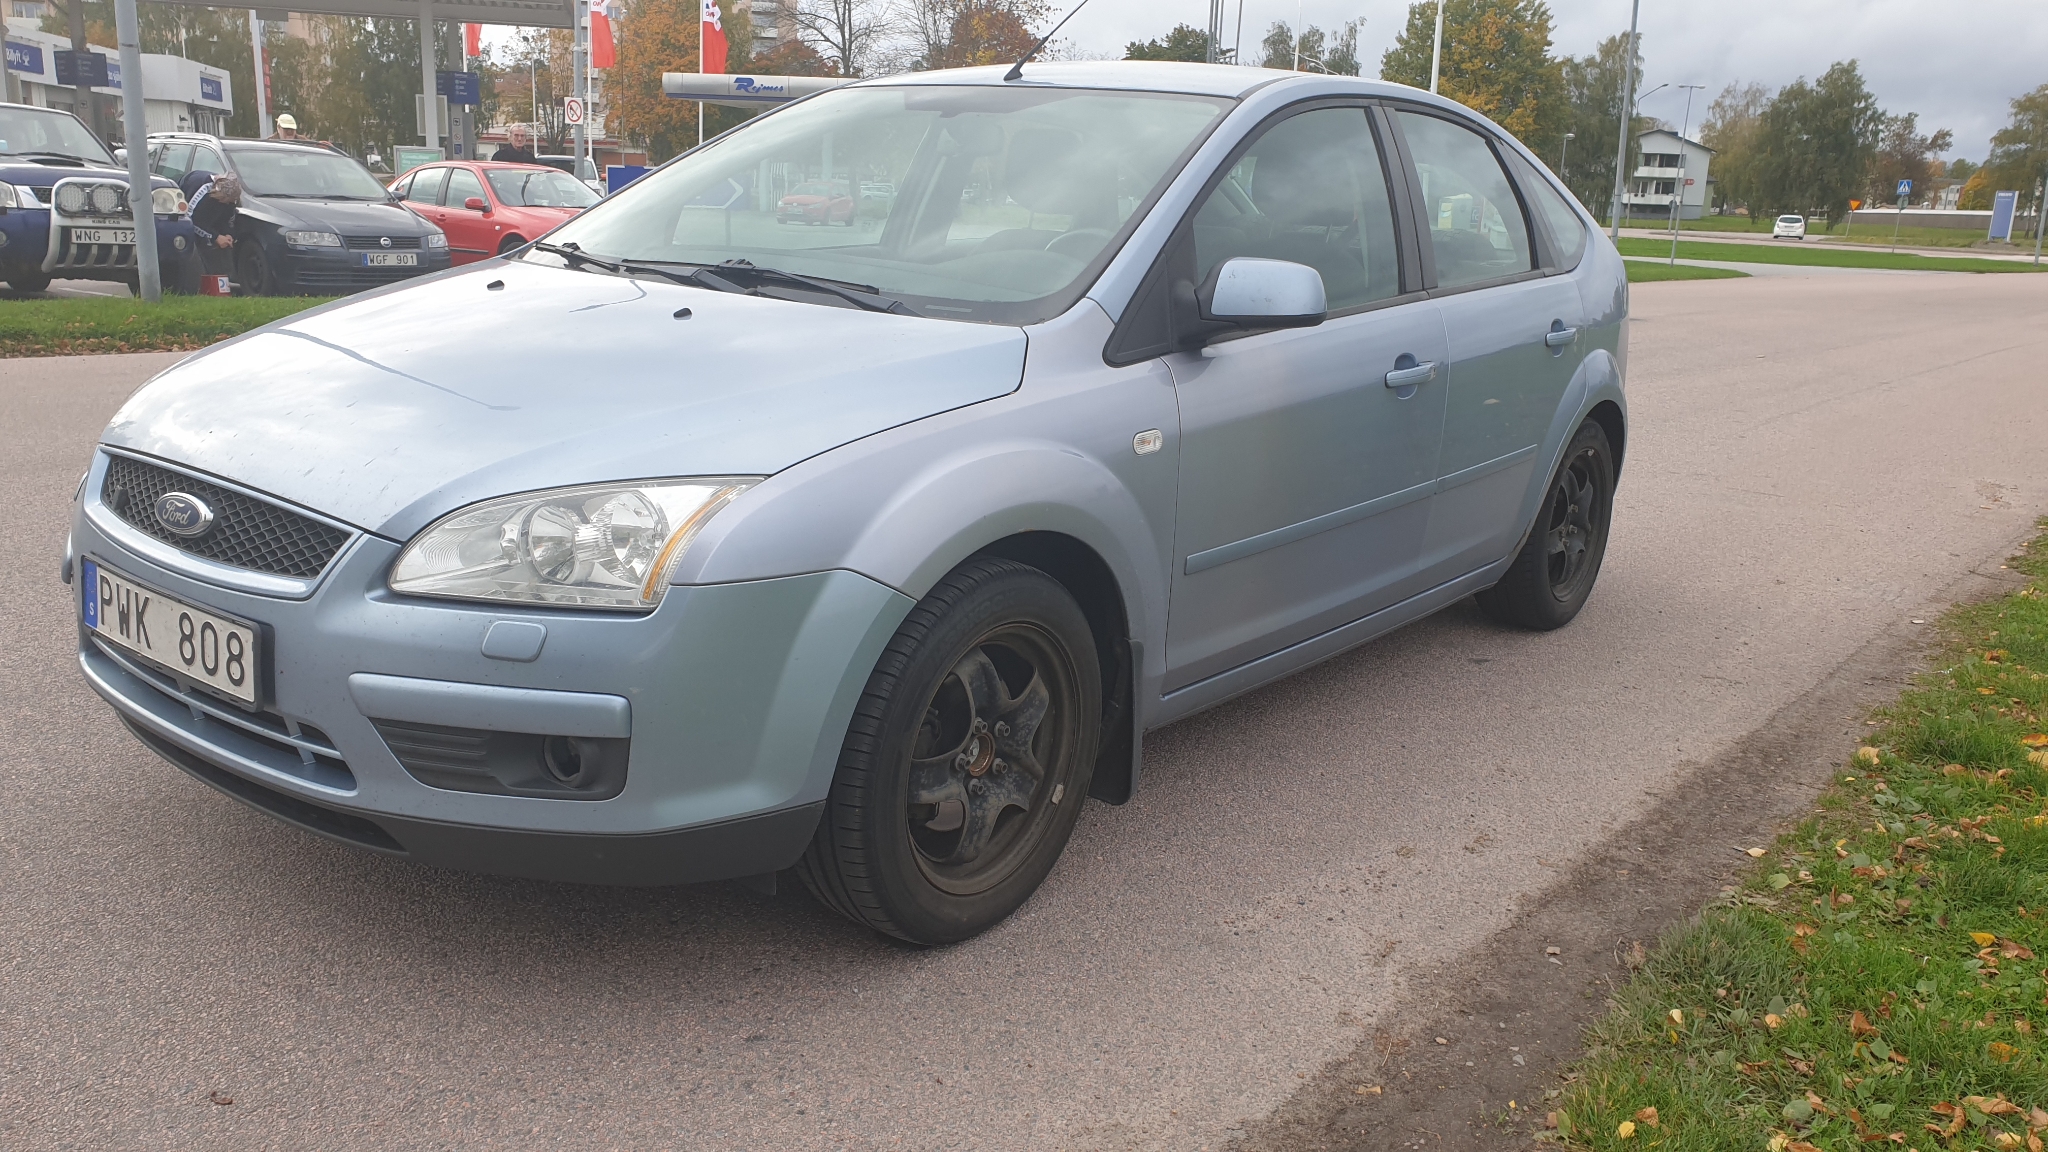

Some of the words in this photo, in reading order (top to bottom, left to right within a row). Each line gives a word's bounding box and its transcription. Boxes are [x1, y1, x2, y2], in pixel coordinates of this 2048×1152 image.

[733, 77, 784, 94] Rejmes
[74, 230, 101, 242] WNG
[113, 231, 137, 243] 132
[368, 254, 389, 265] WGF
[396, 254, 415, 265] 901
[162, 499, 192, 526] Ford
[88, 601, 95, 616] S
[99, 573, 152, 650] PWK
[178, 611, 246, 687] 808
